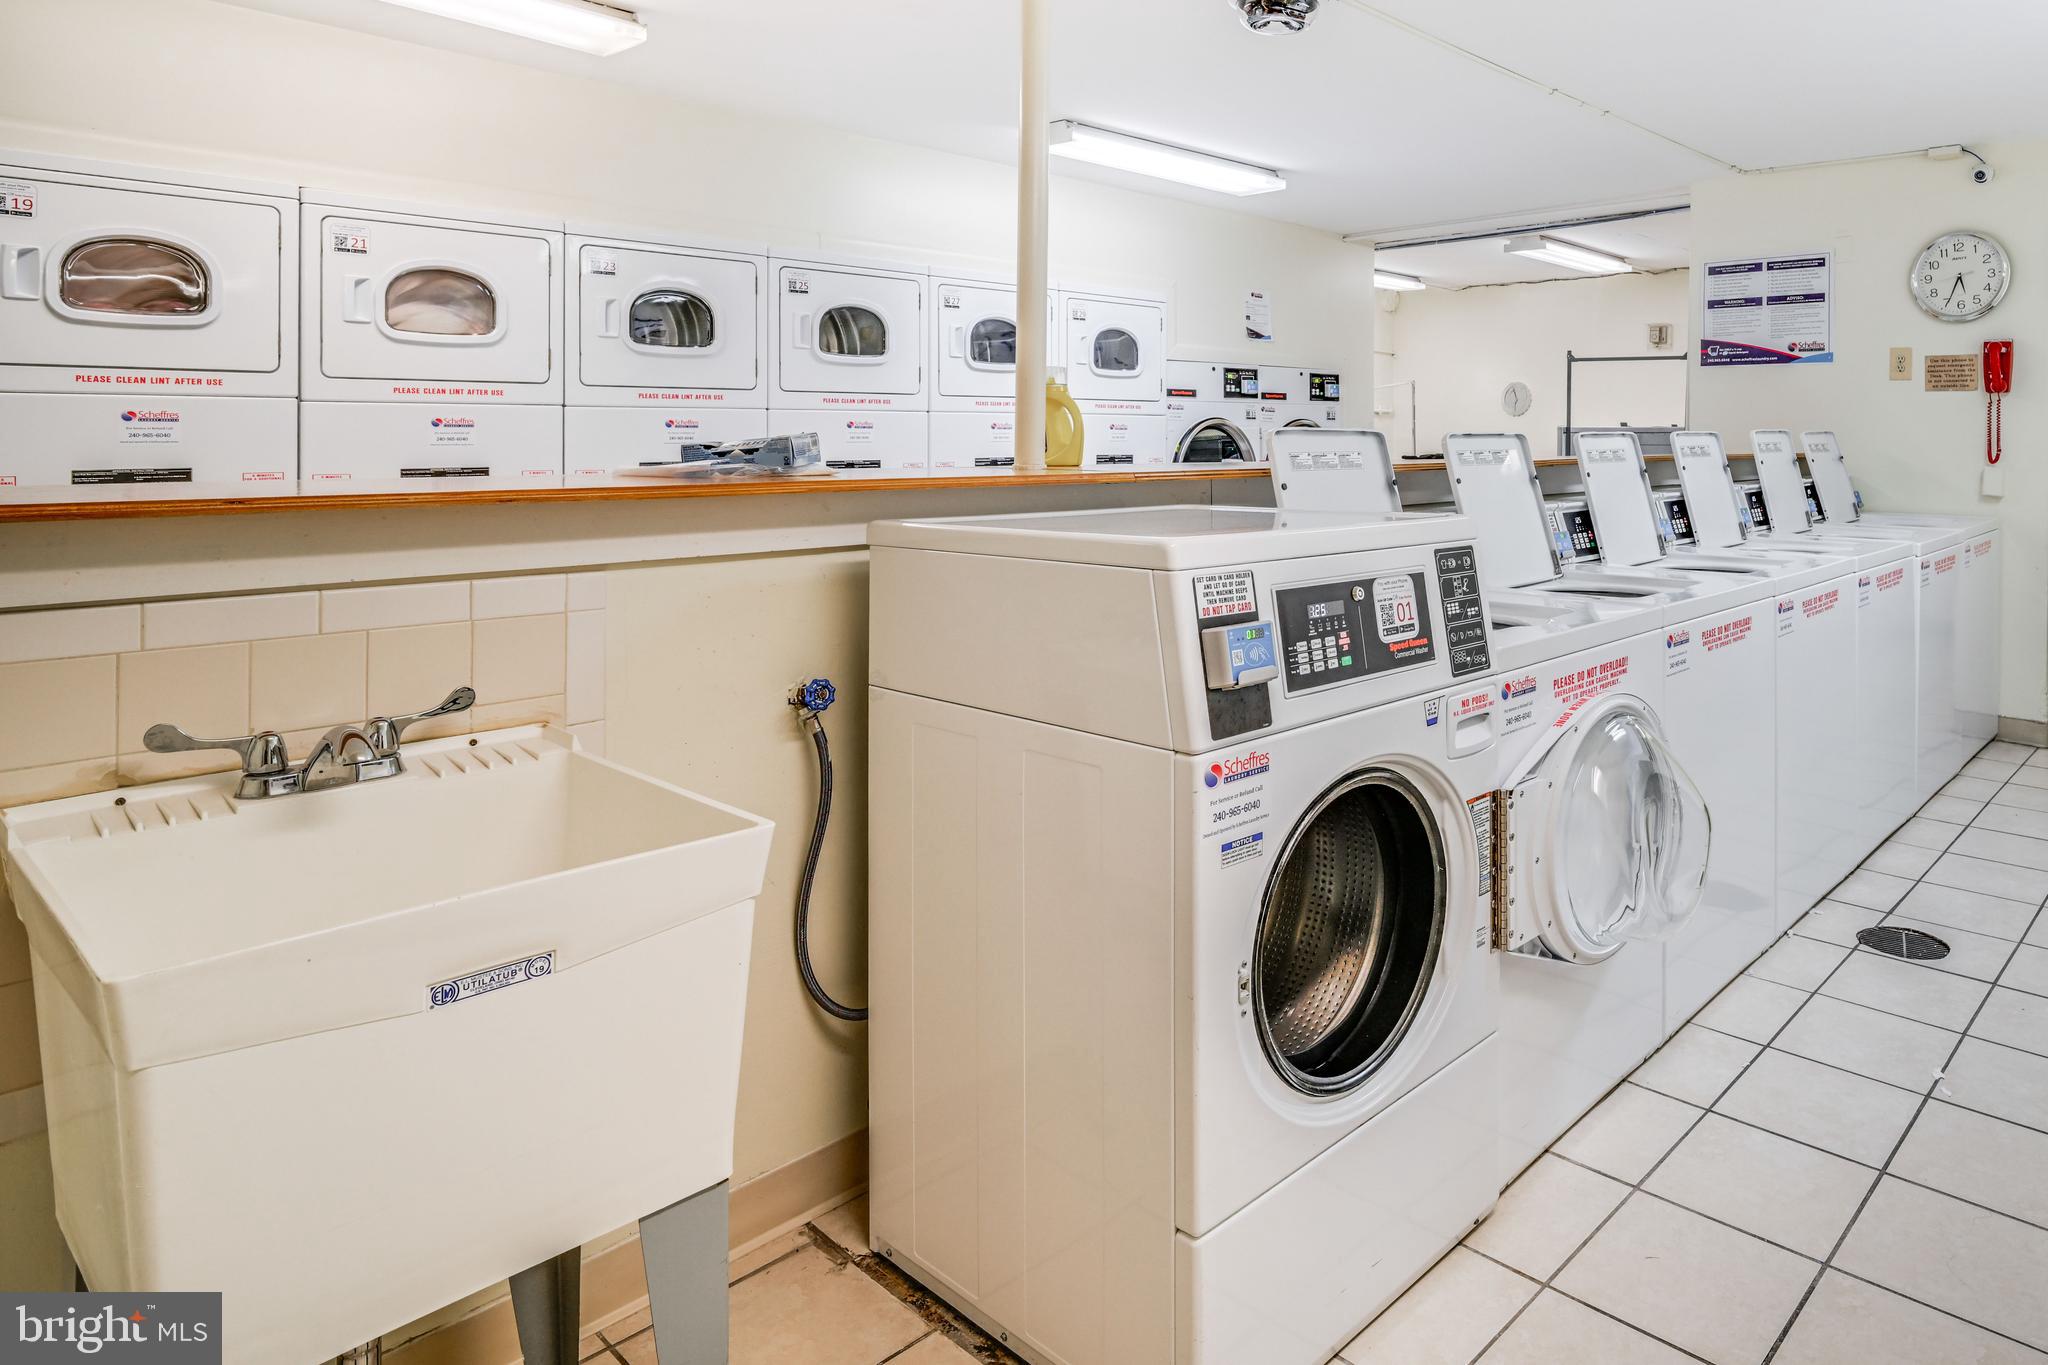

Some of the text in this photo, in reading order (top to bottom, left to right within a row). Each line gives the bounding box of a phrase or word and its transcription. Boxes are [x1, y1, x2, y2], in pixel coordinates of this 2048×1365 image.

[11, 198, 33, 211] 19
[351, 238, 367, 249] 21
[1953, 242, 1965, 252] 12
[1940, 248, 1948, 258] 11
[1982, 254, 1991, 264] 2
[602, 261, 616, 271] 23
[1929, 260, 1940, 270] 10
[1987, 268, 1996, 278] 3
[1924, 274, 1933, 284] 9
[798, 281, 809, 290] 25
[1983, 282, 1991, 292] 4
[1930, 288, 1938, 298] 8
[951, 297, 960, 305] 27
[1972, 295, 1981, 304] 5
[1957, 300, 1966, 310] 6
[1799, 341, 1825, 349] Scheffres
[75, 374, 224, 386] PLEASE CLEAN LINT AFTER USE
[423, 387, 446, 395] CLEAN
[138, 410, 180, 419] Scheffres
[443, 417, 475, 425] Scheffres
[1216, 588, 1234, 596] MACHINE
[1218, 596, 1235, 604] REMOVE
[1202, 601, 1252, 617] DO NOT TAP CARD
[1396, 601, 1415, 622] 01
[1701, 627, 1716, 640] PLEASE
[1717, 625, 1723, 636] DO
[1732, 616, 1752, 630] OVERLOAD!!
[1389, 637, 1428, 652] Speed Queen
[1394, 647, 1429, 659] Commercial Washer
[1553, 655, 1629, 690] PLEASE DO NOT OVERLOAD!!
[1511, 675, 1537, 692] Scheffres
[1554, 682, 1584, 698] OVERLOADING
[1595, 674, 1609, 683] CAUSE
[1610, 667, 1628, 678] MACHINE
[1562, 696, 1570, 704] NOT
[1580, 687, 1598, 697] OPERATE
[1461, 698, 1470, 708] NO
[1224, 751, 1270, 776] Scheffres
[1224, 765, 1270, 784] LAUNDRY SERVICE
[1218, 795, 1235, 805] Service
[1240, 787, 1255, 798] Refund
[1212, 799, 1261, 823] 240-965-6040
[1231, 835, 1254, 848] NOTICE
[534, 965, 545, 974] 19
